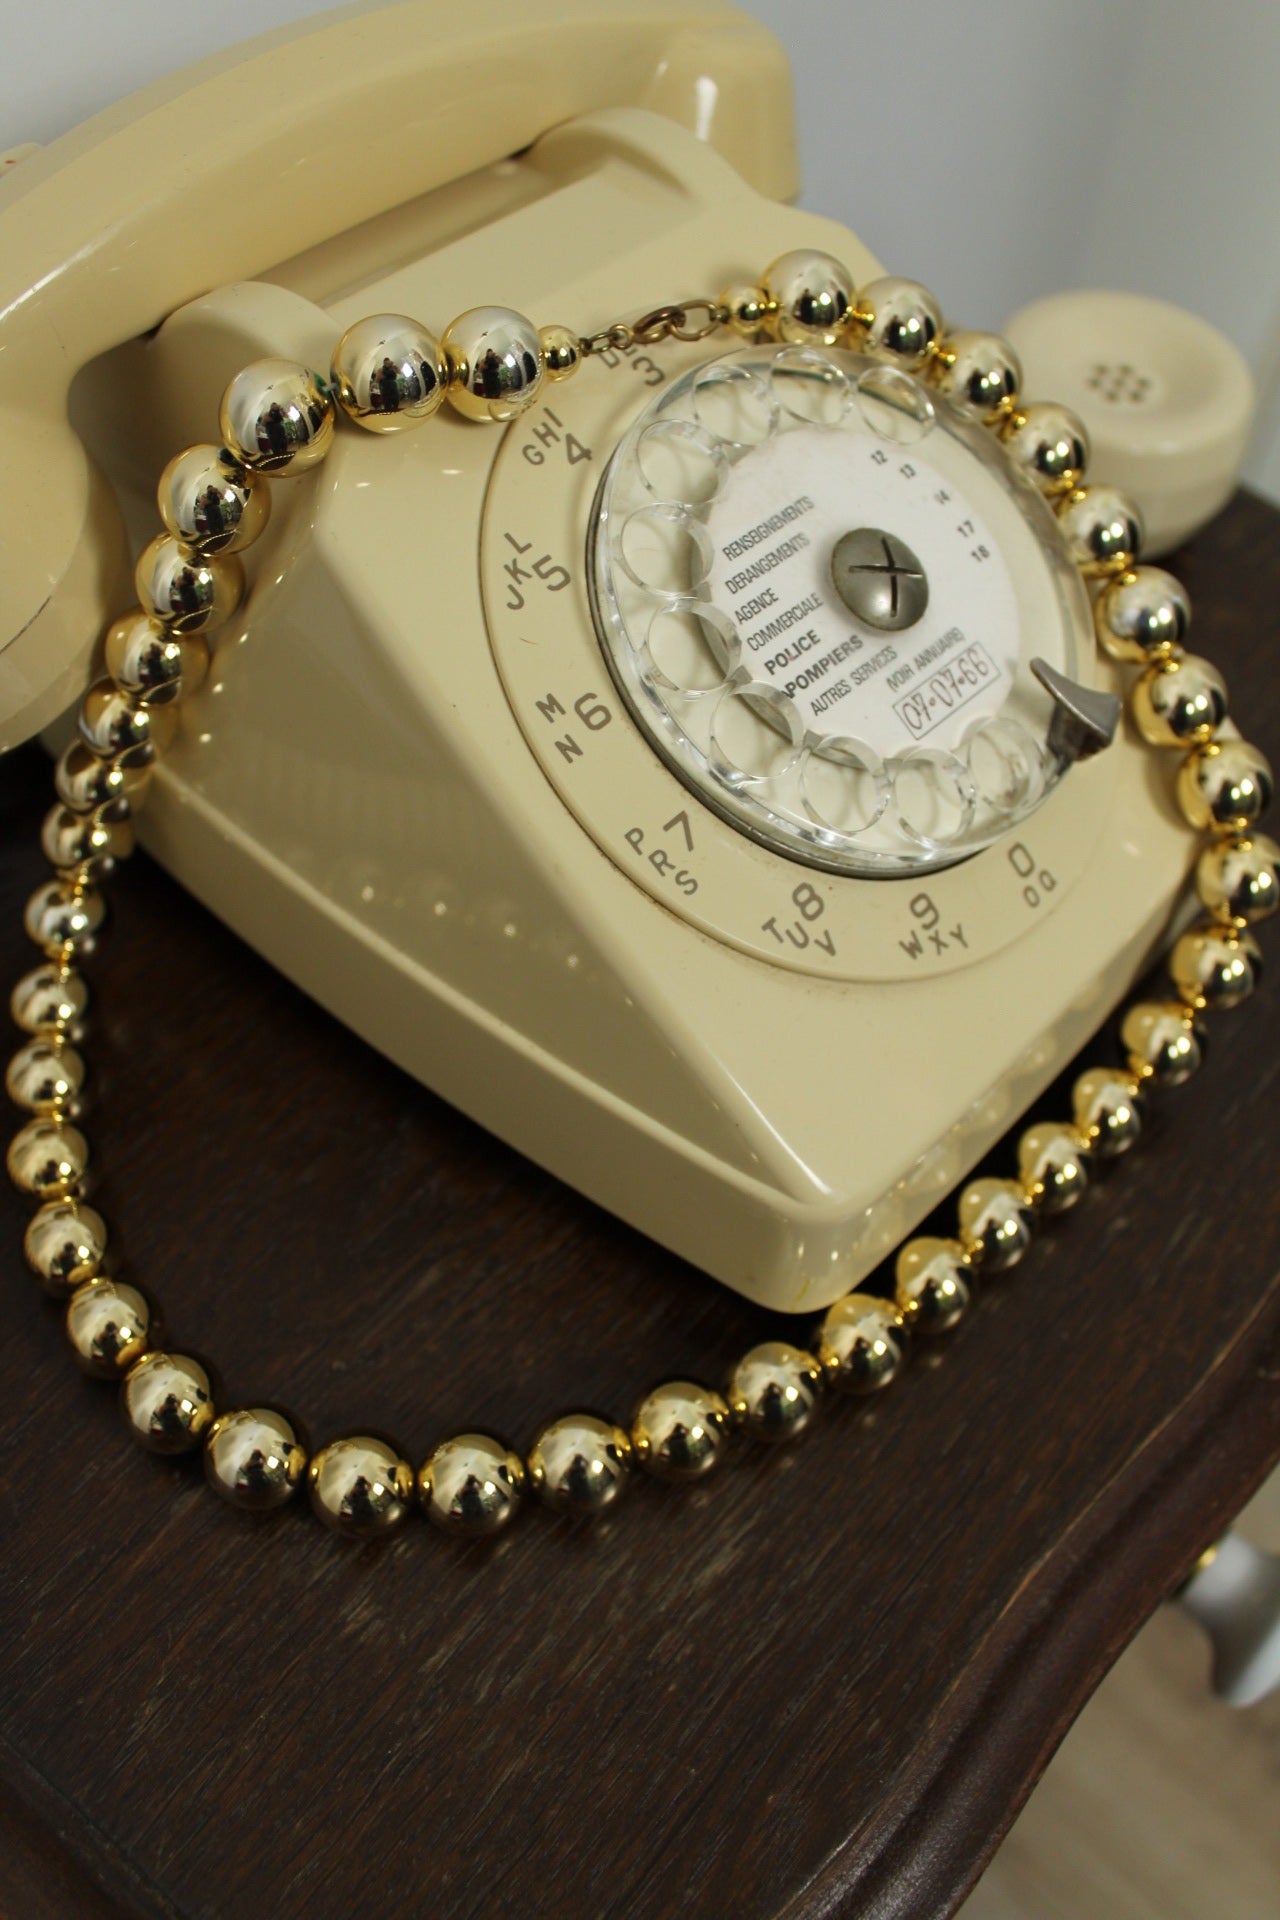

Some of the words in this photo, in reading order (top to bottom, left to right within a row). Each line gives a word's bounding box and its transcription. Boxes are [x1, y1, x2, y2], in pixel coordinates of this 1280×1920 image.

[632, 356, 666, 387] 3
[565, 432, 592, 466] 4
[871, 449, 888, 465] 12
[899, 463, 917, 479] 13
[721, 495, 815, 561] RENSEIGNEMENTS
[957, 519, 975, 538] 17
[531, 554, 572, 592] 5
[724, 532, 811, 595] DERANGEMENTS
[733, 587, 780, 625] AGENCE
[746, 591, 825, 651] COMMERCIALE
[763, 628, 821, 676] POLICE
[782, 634, 864, 699] POMPIERS
[810, 679, 852, 716] AUTRES
[850, 645, 898, 686] SERVICES
[574, 692, 613, 731] 6
[662, 810, 694, 852] 7
[791, 882, 825, 922] 8
[909, 892, 940, 930] 9
